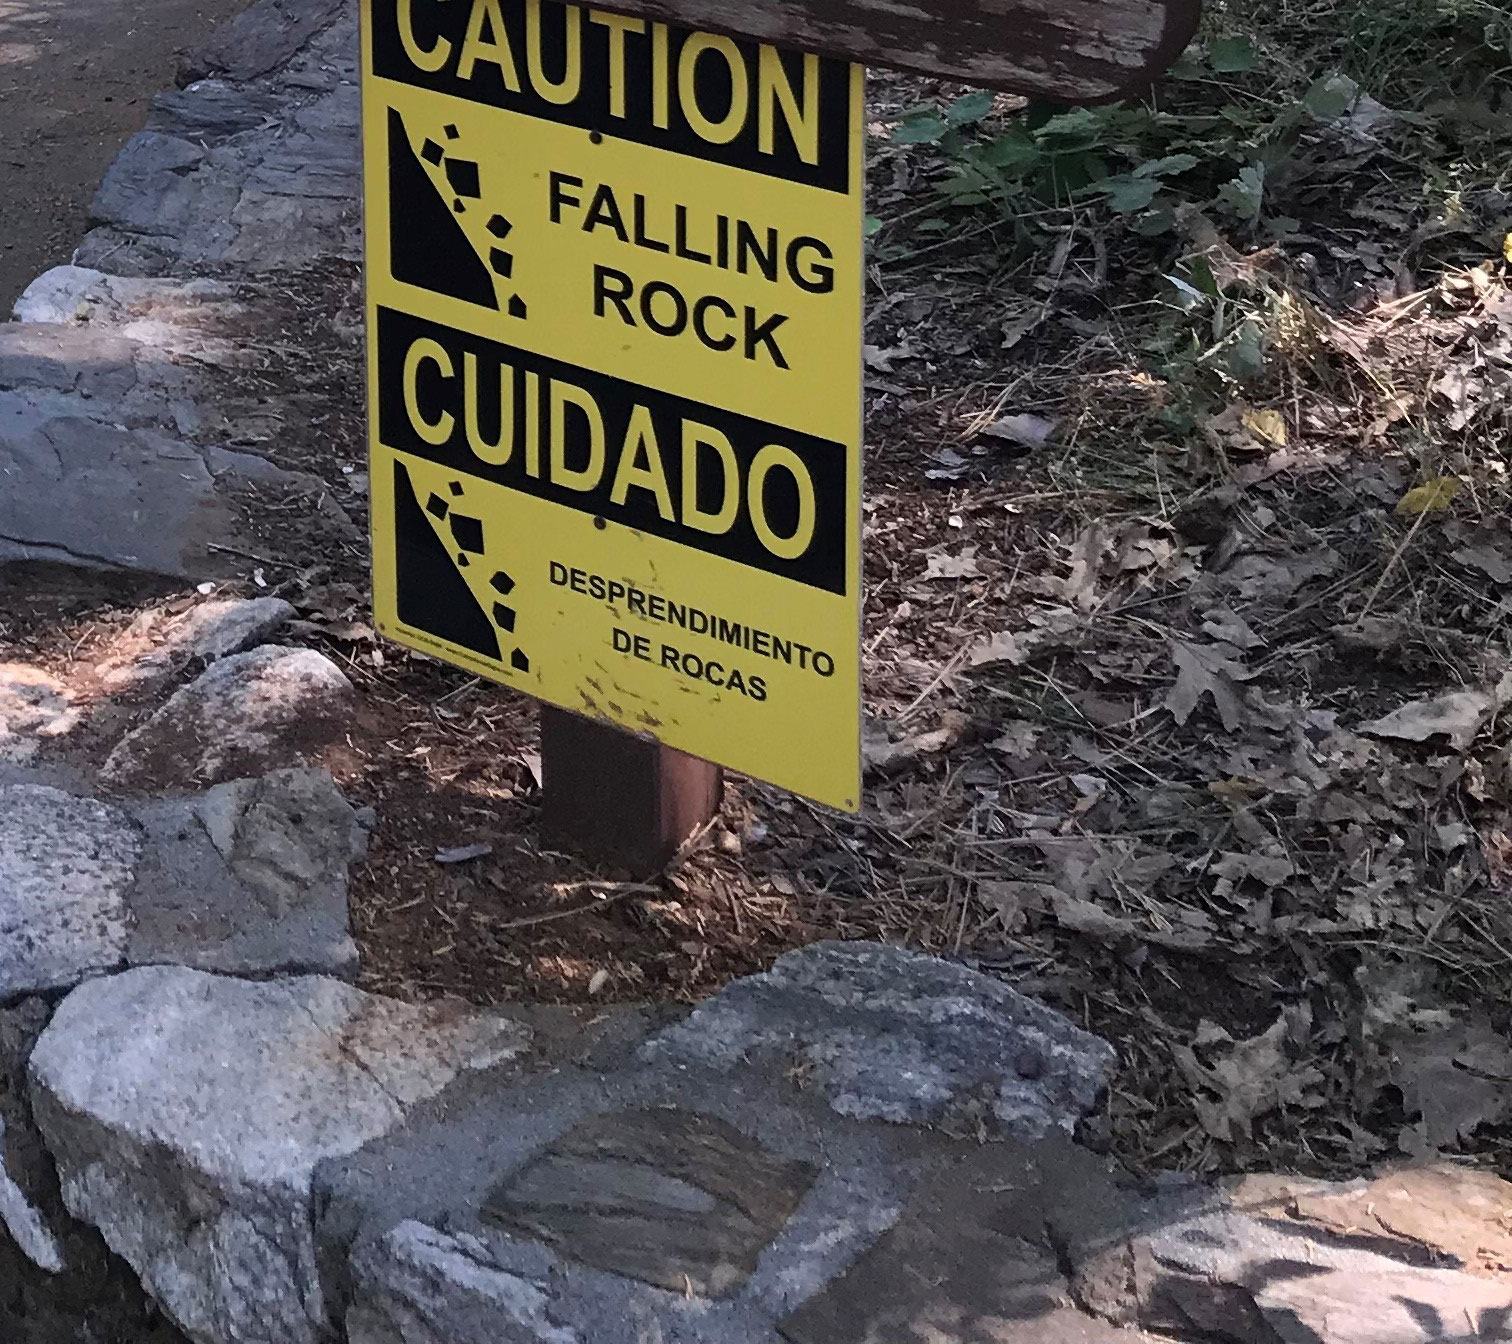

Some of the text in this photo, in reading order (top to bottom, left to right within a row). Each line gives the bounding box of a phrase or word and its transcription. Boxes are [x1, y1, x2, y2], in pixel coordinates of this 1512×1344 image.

[548, 169, 836, 296] FALLING
[592, 262, 791, 372] ROCK
[402, 335, 817, 561] CUIDADO
[548, 559, 837, 680] DESPRENDIMIENTO
[611, 626, 769, 704] DE ROCAS
